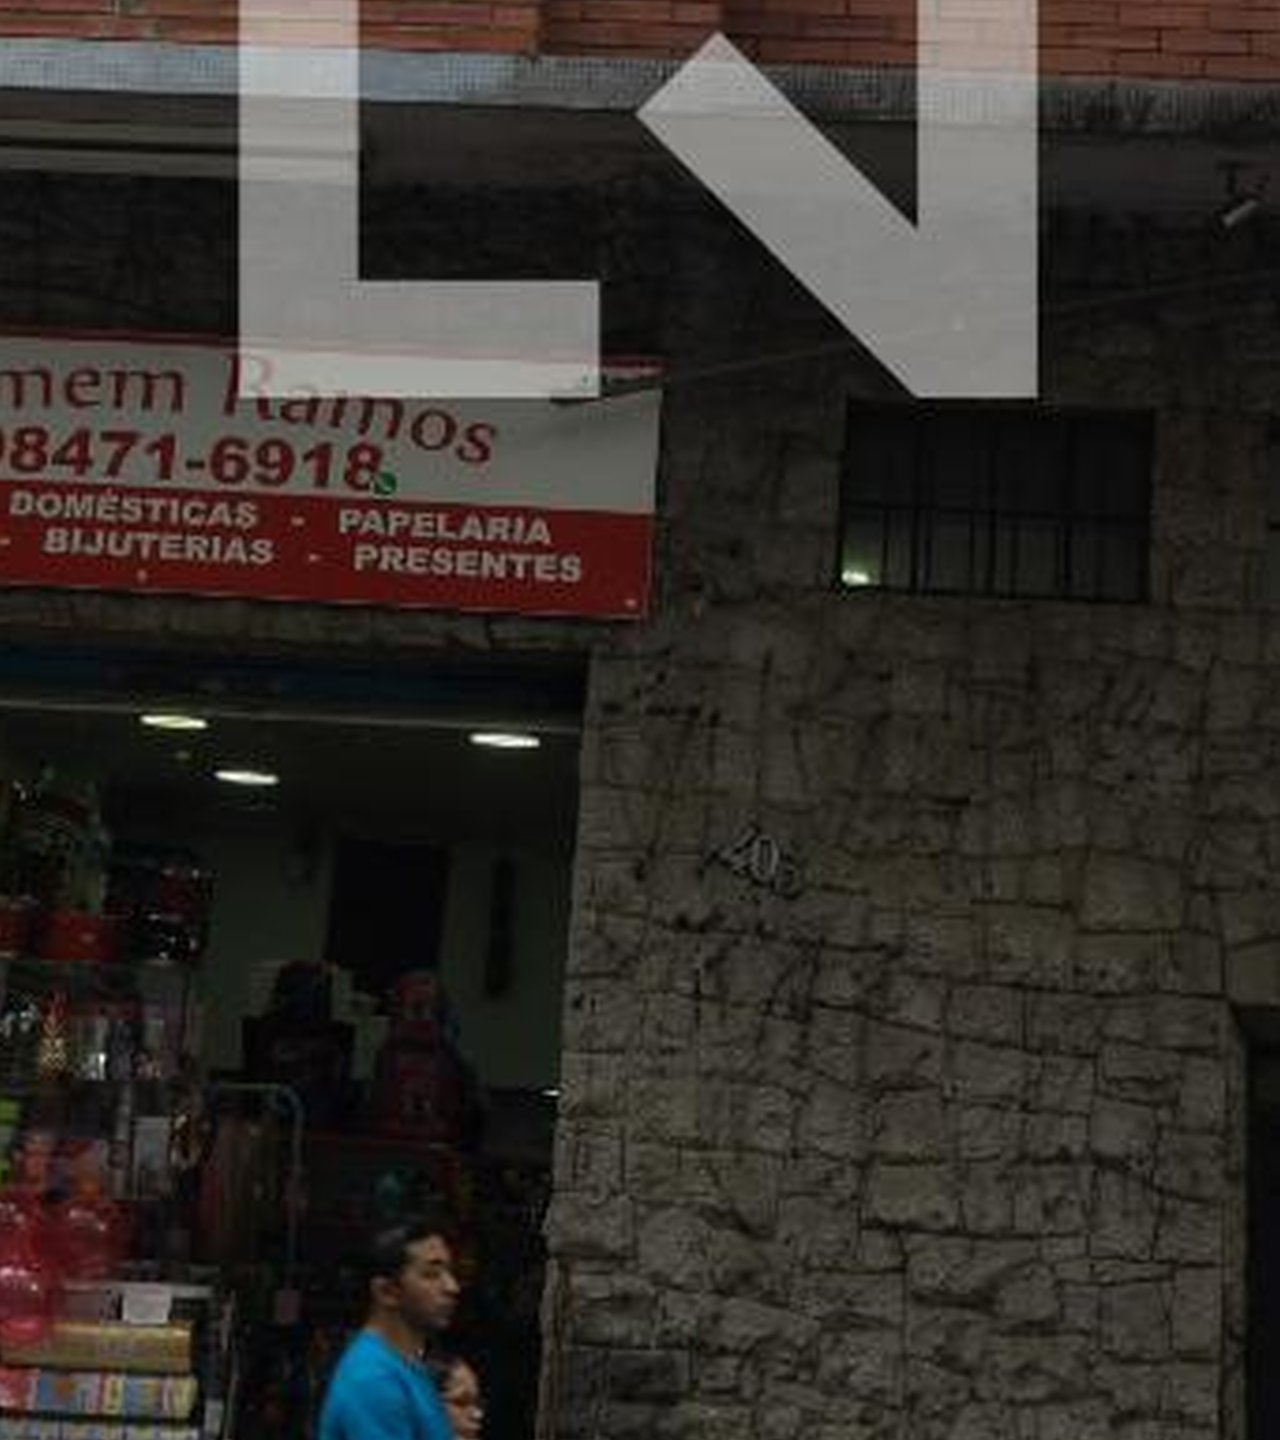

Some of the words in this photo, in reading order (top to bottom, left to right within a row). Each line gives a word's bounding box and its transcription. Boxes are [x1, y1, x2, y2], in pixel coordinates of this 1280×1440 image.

[223, 353, 500, 465] Ramos
[10, 487, 260, 531] DOMÉSTICAS
[338, 507, 554, 547] PAPELARIA
[43, 529, 276, 567] BIJUTERIAS
[353, 543, 585, 583] PRESENTES
